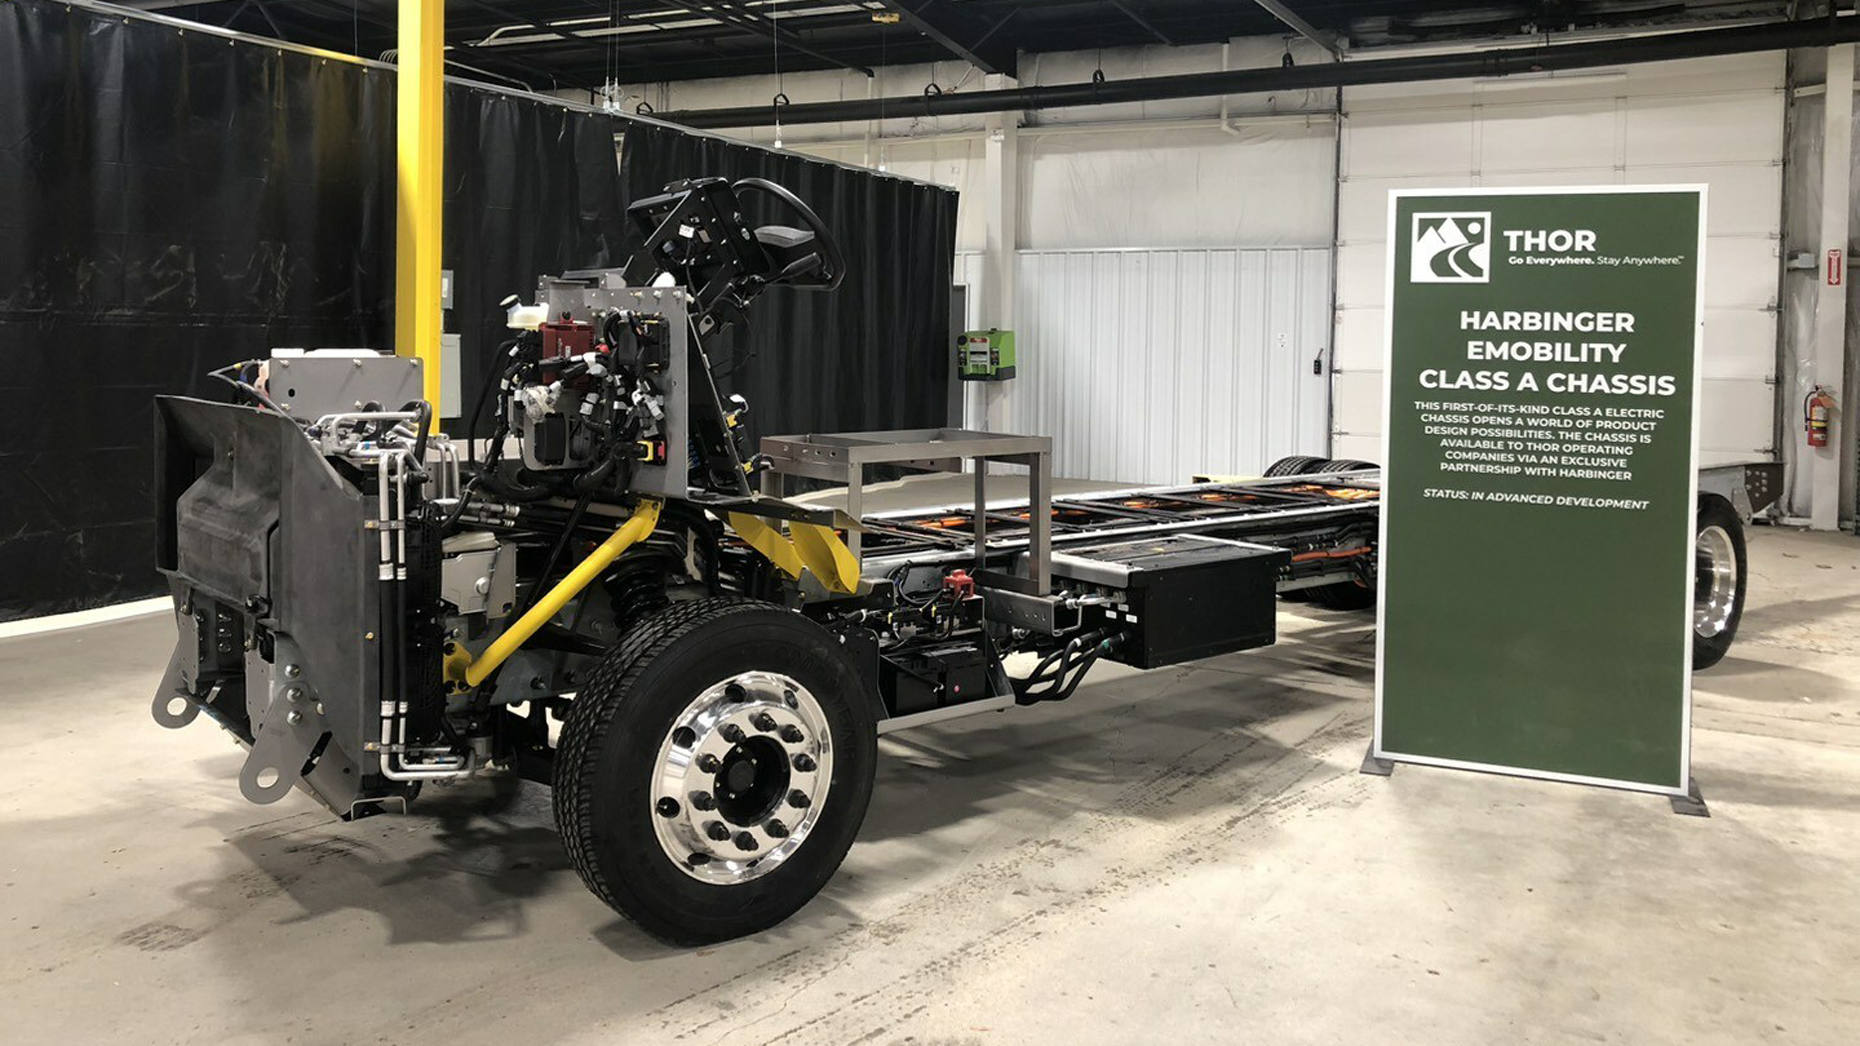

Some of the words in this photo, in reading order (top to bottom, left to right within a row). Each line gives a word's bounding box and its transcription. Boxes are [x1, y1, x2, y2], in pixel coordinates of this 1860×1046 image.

[1503, 230, 1596, 251] THOR
[1509, 256, 1524, 264] Go
[1526, 256, 1594, 266] Everywhere.
[1597, 256, 1620, 266] Stay
[1461, 311, 1634, 332] HARBINGER
[1468, 341, 1626, 362] EMOBILITY
[1420, 369, 1509, 390] CLASS
[1517, 372, 1539, 391] A
[1547, 373, 1675, 395] CHASSIS
[1414, 401, 1440, 410] THIS
[1443, 403, 1549, 414] FIRST-OF-ITS-KIND
[1552, 406, 1591, 416] CLASS
[1593, 408, 1602, 416] A
[1606, 408, 1664, 418] ELECTRIC
[1421, 414, 1469, 423] CHASSIS
[1472, 416, 1512, 425] OPENS
[1527, 418, 1573, 427] WORLD
[1576, 420, 1593, 428] OF
[1596, 420, 1656, 430] PRODUCT
[1425, 426, 1467, 435] DESIGN
[1471, 428, 1555, 439] POSSIBILITIES.
[1558, 431, 1581, 440] THE
[1585, 432, 1637, 443] CHASSIS
[1640, 435, 1651, 443] IS
[1440, 439, 1504, 449] AVAILABLE
[1507, 441, 1523, 450] TO
[1526, 442, 1560, 452] THOR
[1562, 444, 1633, 455] OPERATING
[1445, 451, 1514, 462] COMPANIES
[1517, 454, 1537, 463] VIA
[1540, 456, 1558, 464] AN
[1561, 456, 1627, 467] EXCLUSIVE
[1441, 463, 1521, 474] PARTNERSHIP
[1525, 467, 1556, 476] WITH
[1560, 469, 1632, 480] HARBINGER
[1424, 489, 1469, 499] STATUS:
[1471, 492, 1484, 500] IN
[1486, 493, 1553, 504] ADVANCED
[1556, 496, 1649, 509] DEVELOPMENT
